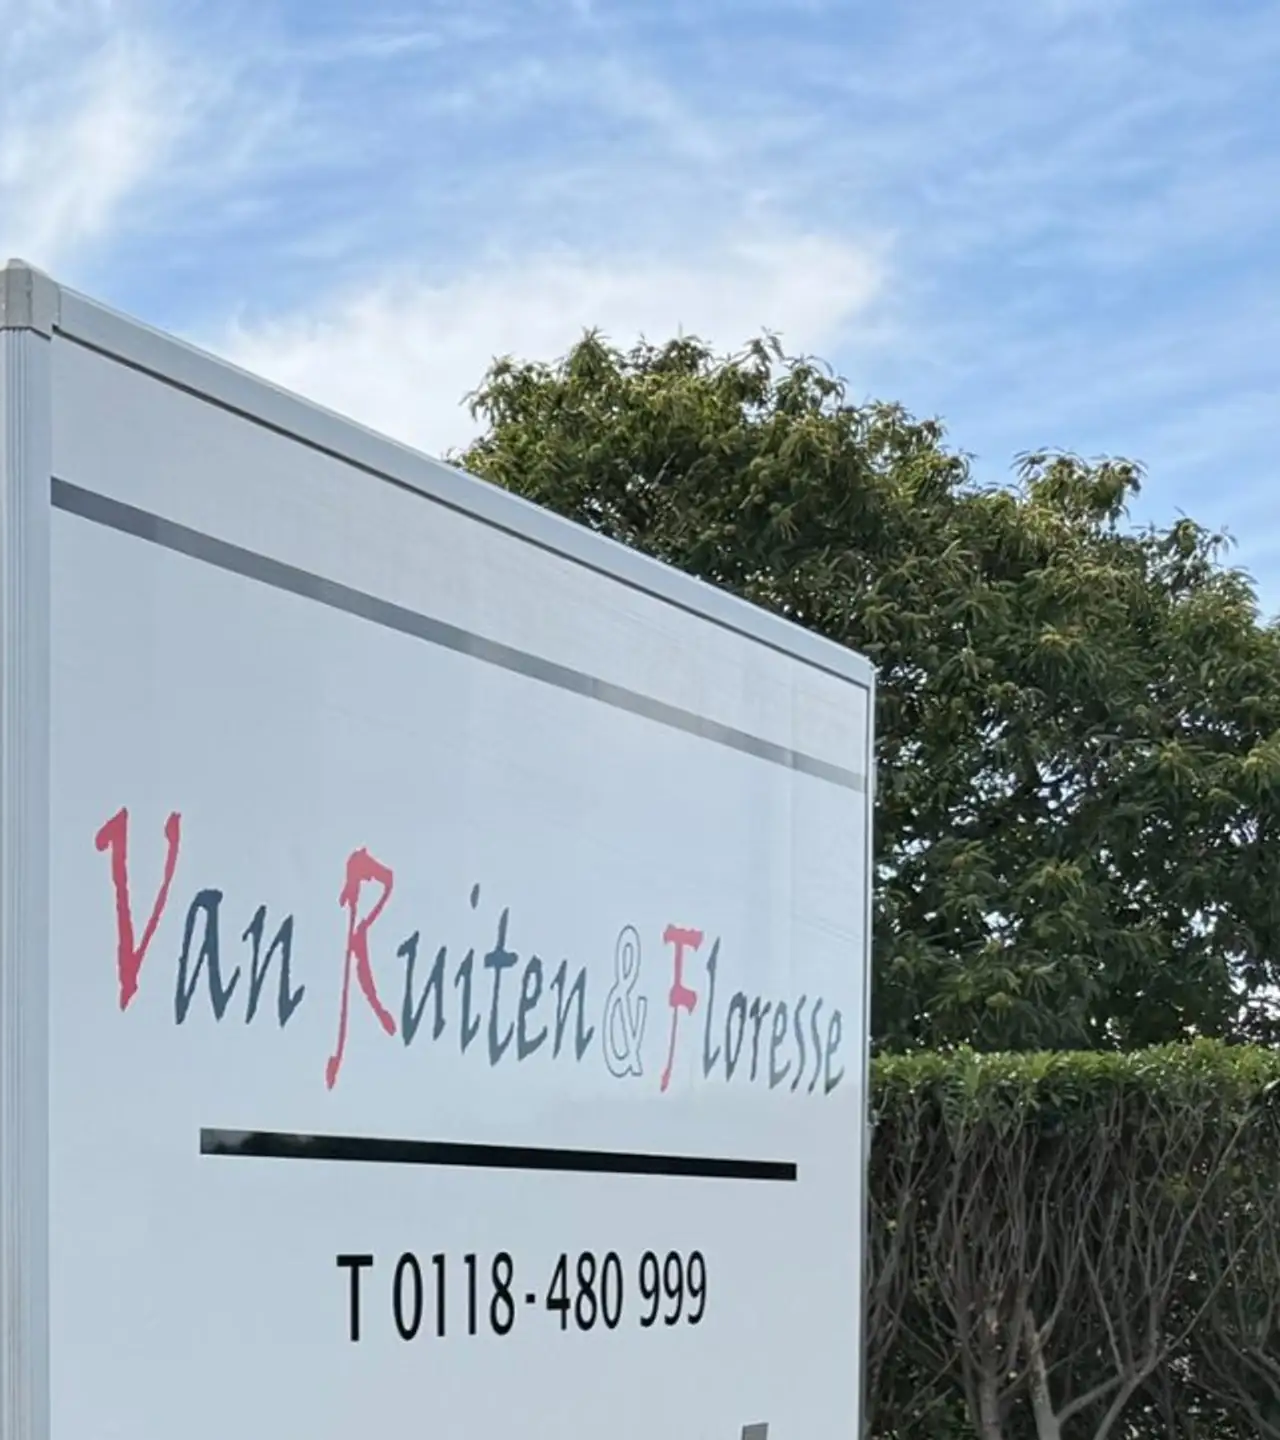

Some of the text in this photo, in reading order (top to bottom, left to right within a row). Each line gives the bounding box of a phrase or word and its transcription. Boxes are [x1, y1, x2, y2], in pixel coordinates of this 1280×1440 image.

[95, 806, 305, 1025] Van
[325, 846, 596, 1091] Ruiten
[659, 923, 845, 1096] Floresse
[336, 1253, 375, 1342] T
[638, 1249, 708, 1328] 999
